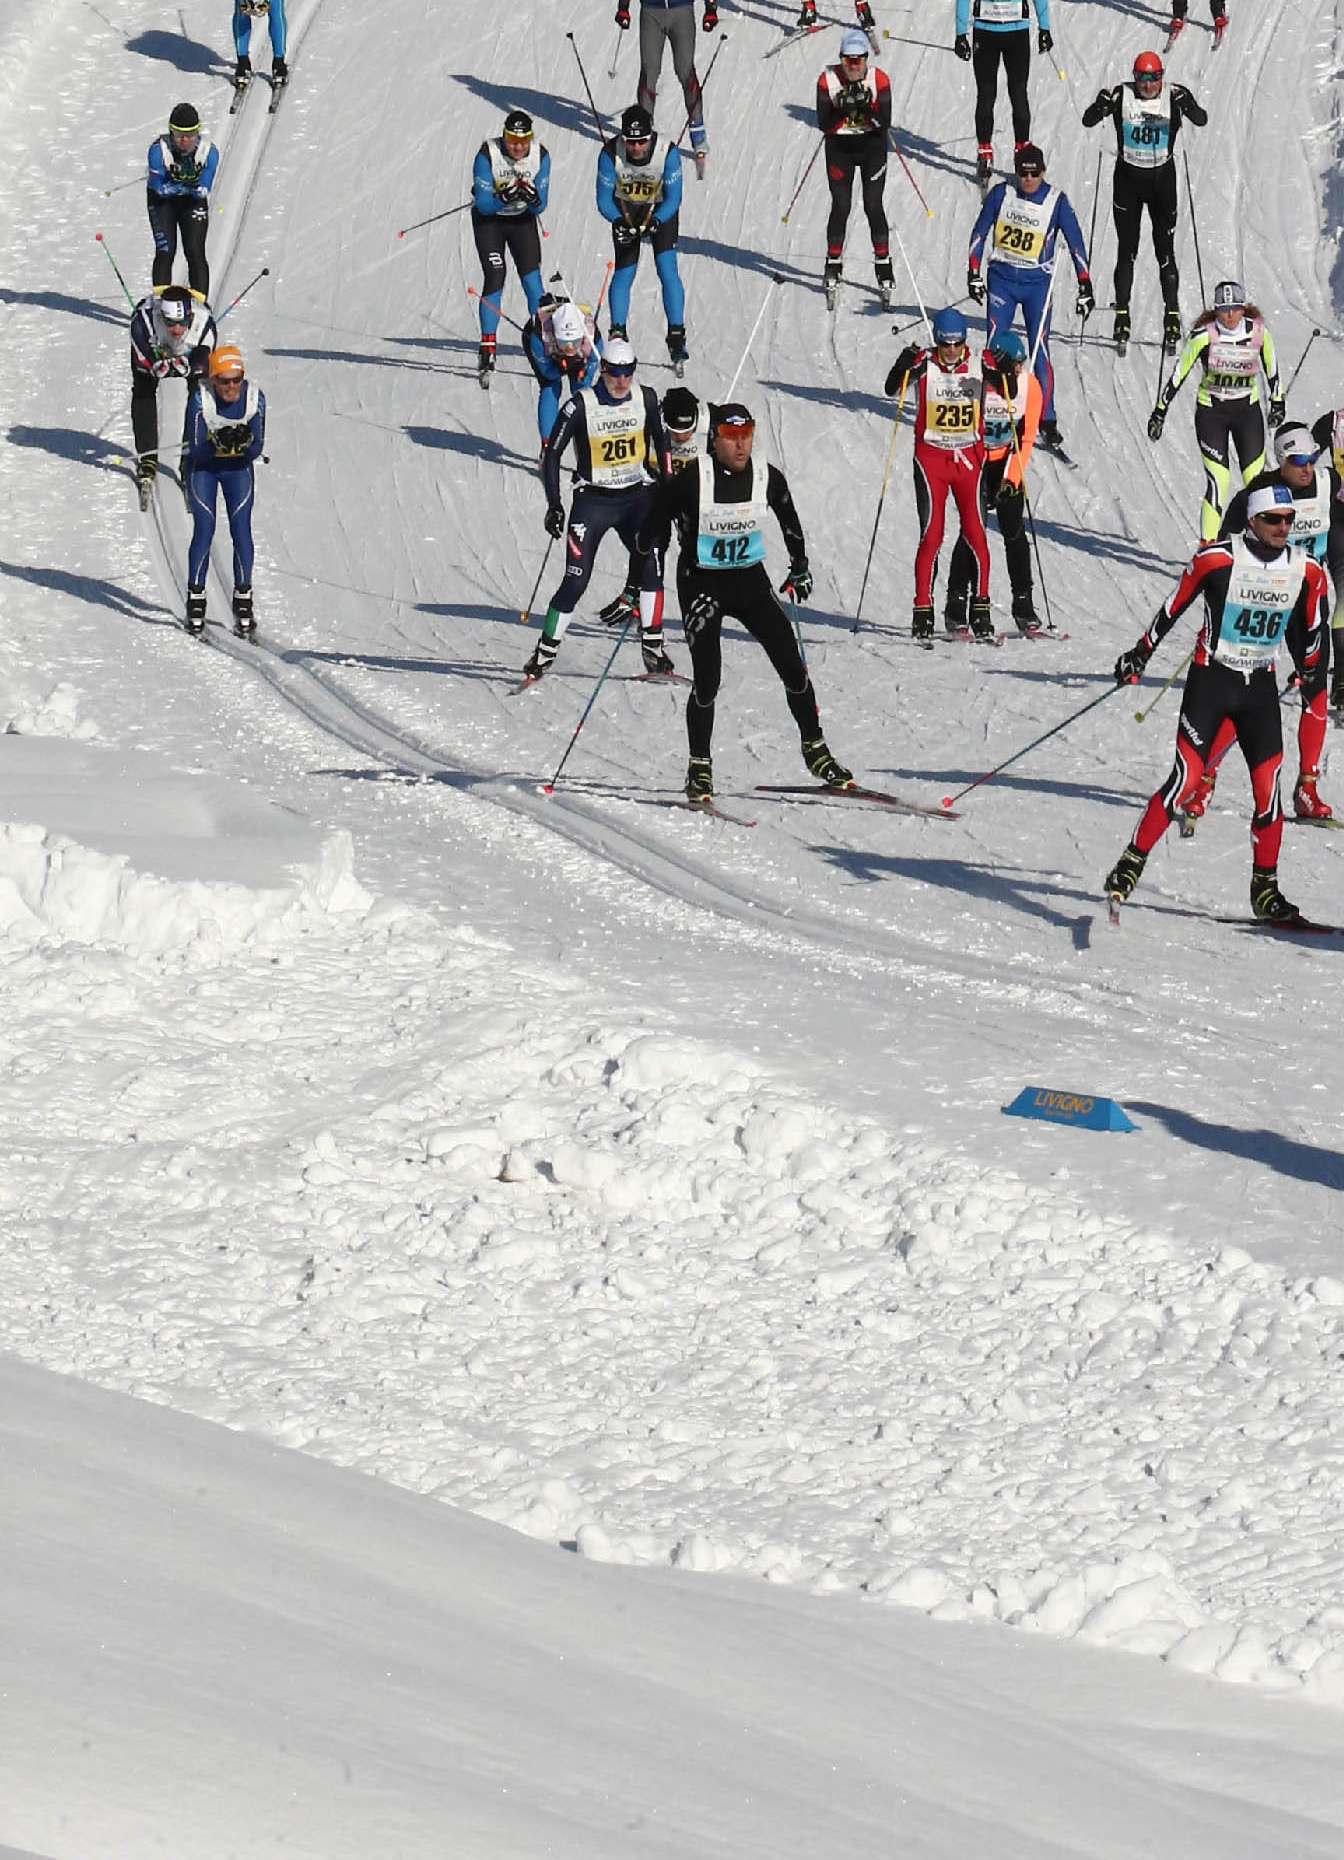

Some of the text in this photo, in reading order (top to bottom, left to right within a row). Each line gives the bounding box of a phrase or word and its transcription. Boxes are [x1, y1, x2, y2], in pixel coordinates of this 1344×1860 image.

[1005, 210, 1040, 228] LIVIGNO
[999, 225, 1035, 252] 238
[935, 404, 974, 428] 235
[986, 406, 1017, 415] VIGNO
[597, 417, 638, 432] LIVIGNO
[601, 437, 637, 463] 261
[709, 518, 757, 533] LIVIGNO
[711, 537, 750, 563] 412
[1240, 587, 1289, 603] LIVIGNO
[1233, 608, 1284, 639] 436
[1034, 1090, 1095, 1114] LIVIGNO
